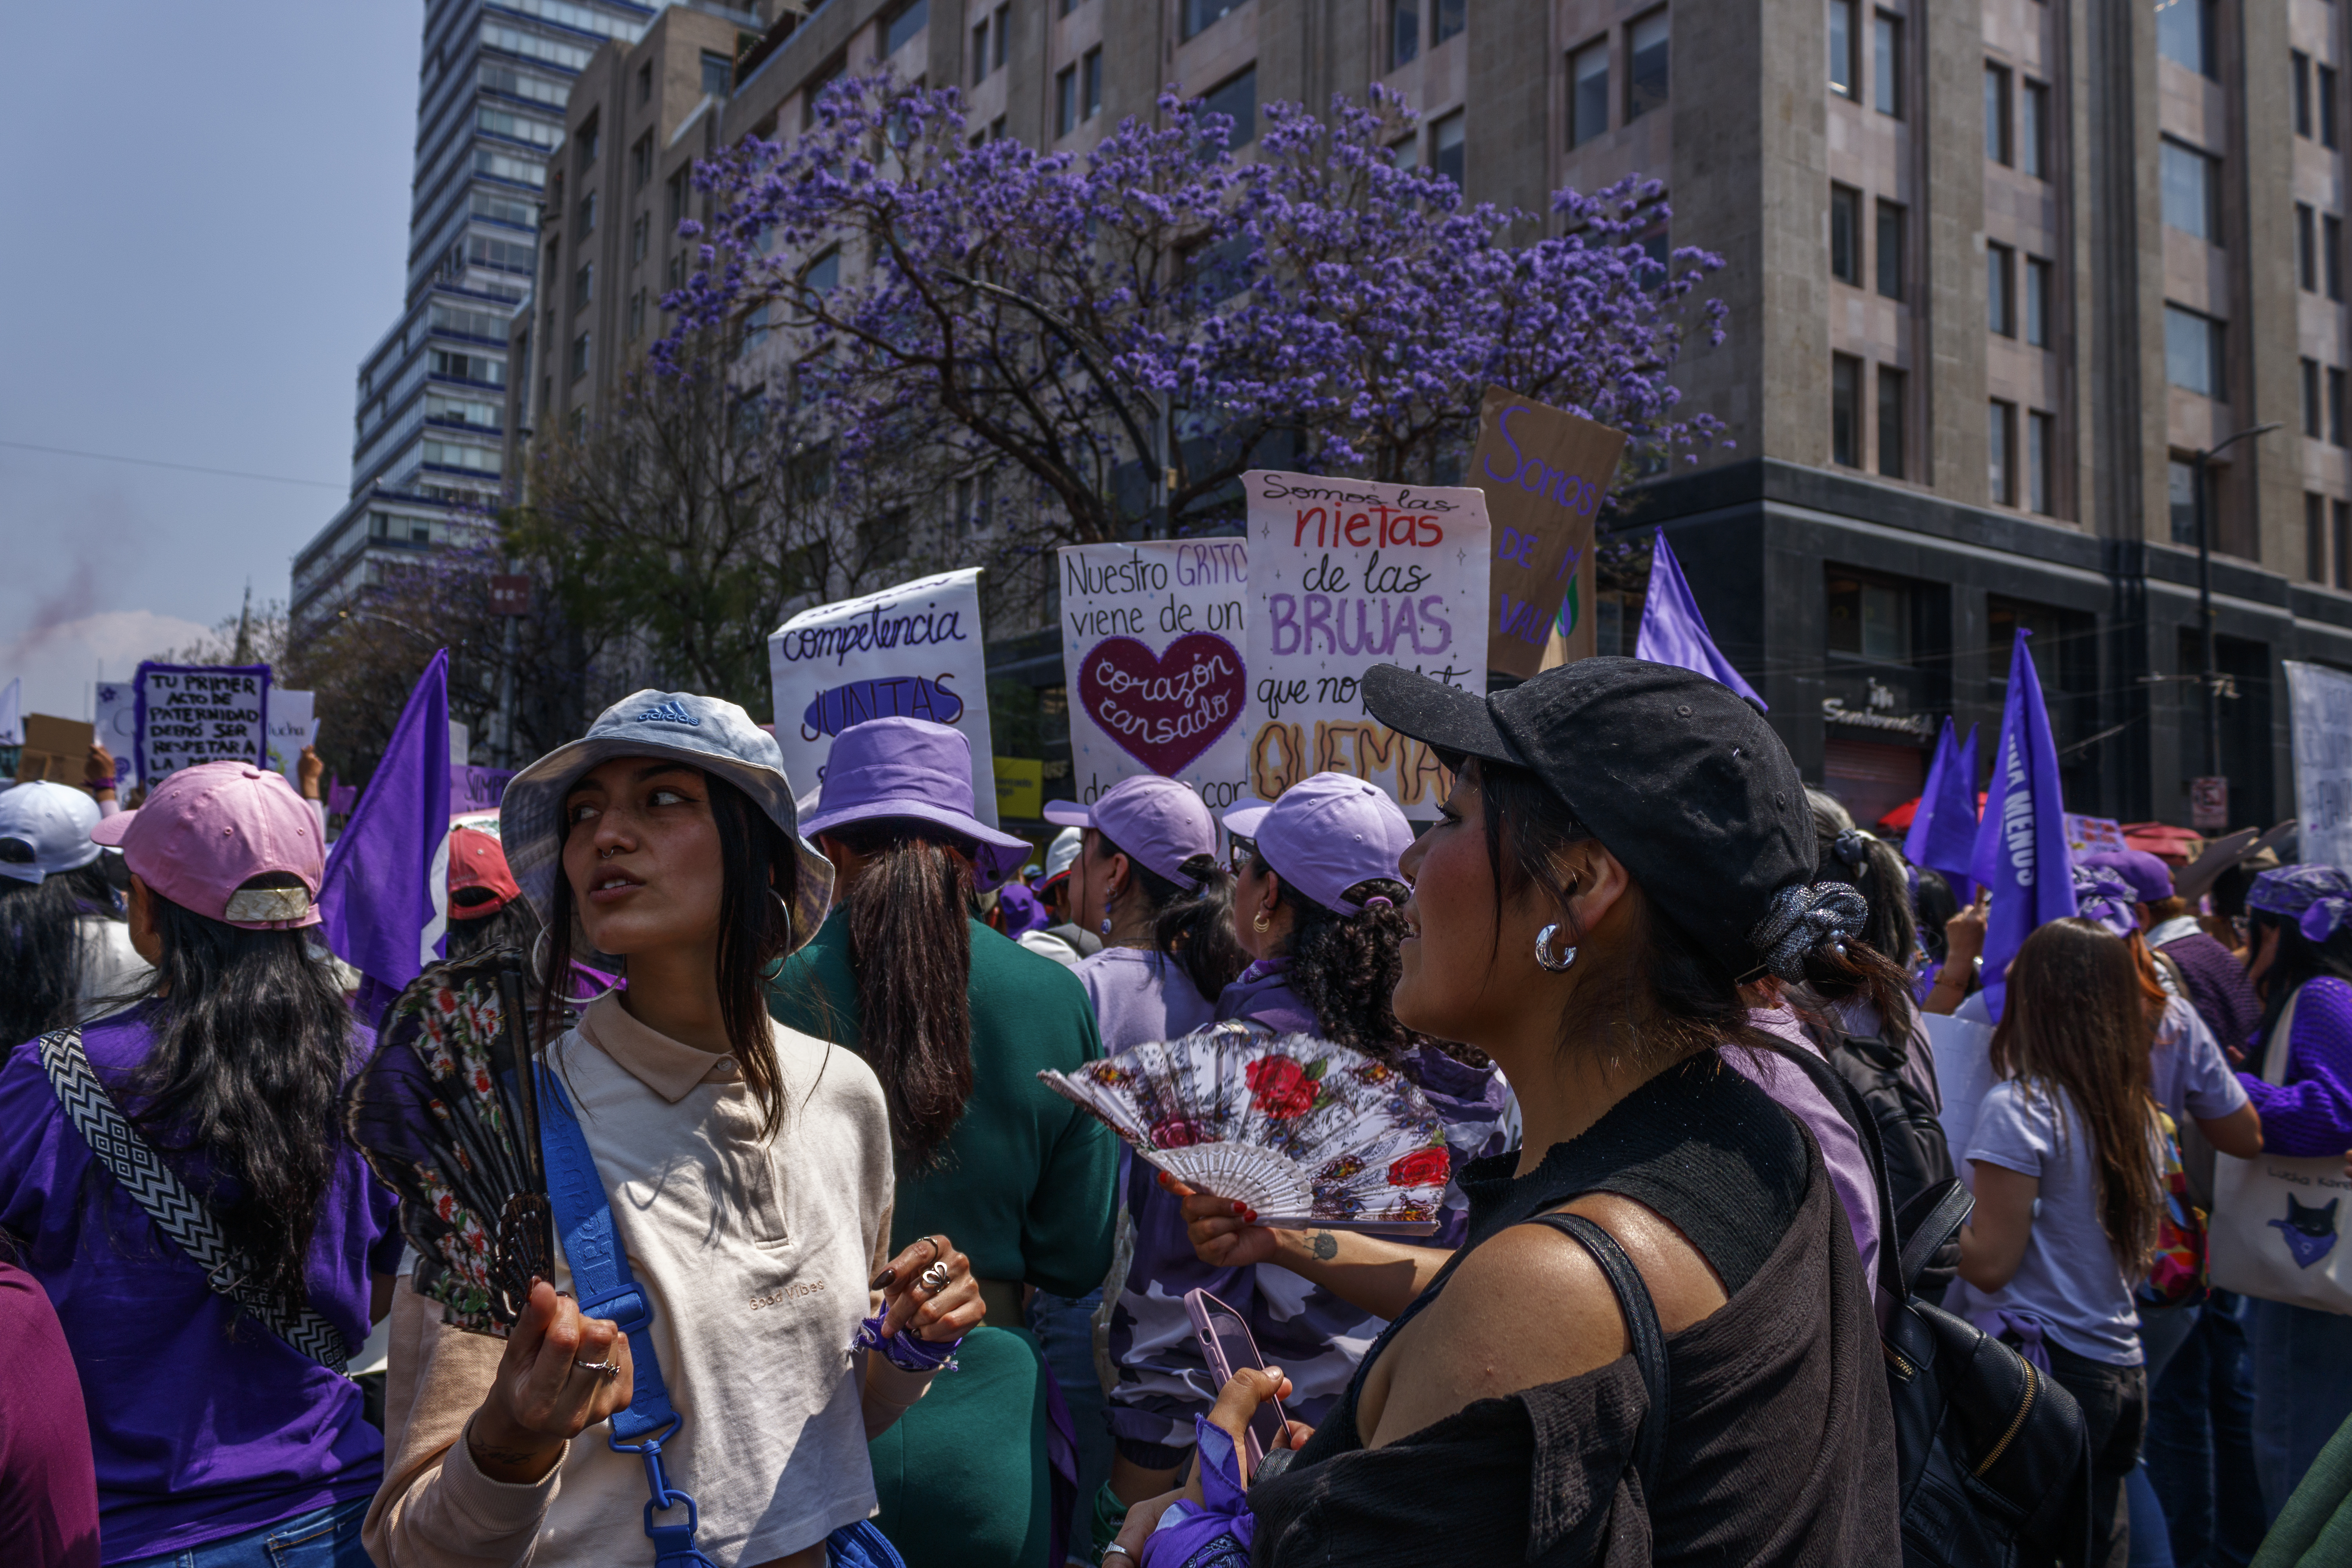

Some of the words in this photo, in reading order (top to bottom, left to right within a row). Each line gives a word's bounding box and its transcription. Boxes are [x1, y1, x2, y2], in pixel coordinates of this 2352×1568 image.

[1263, 474, 1388, 505] Somos
[1397, 489, 1460, 512] las
[1294, 501, 1443, 548] nietas
[1497, 526, 1538, 569] DE
[1066, 548, 1168, 597] Nuestro
[1303, 553, 1350, 593] de
[1364, 550, 1431, 594] las
[783, 603, 967, 666] competencia
[1069, 601, 1144, 637] viene
[1160, 593, 1192, 633] de
[1207, 600, 1244, 631] un
[1270, 593, 1452, 656] BRUJAS
[150, 675, 178, 688] TU
[184, 677, 256, 695] PRIMER
[166, 693, 208, 706] ACTO
[212, 693, 232, 704] DE
[1096, 653, 1234, 708] corazón
[1258, 679, 1309, 719] que
[1318, 676, 1357, 703] no
[150, 708, 259, 722] PATERNIDAD
[637, 711, 699, 726] adidas
[800, 673, 964, 742] JUNTAS
[1099, 688, 1231, 744] cansado
[153, 740, 239, 754] RESPETAR
[243, 741, 256, 754] A
[213, 724, 247, 738] SER
[151, 758, 174, 770] LA
[749, 1290, 783, 1310] Good
[785, 1280, 824, 1299] Vibes
